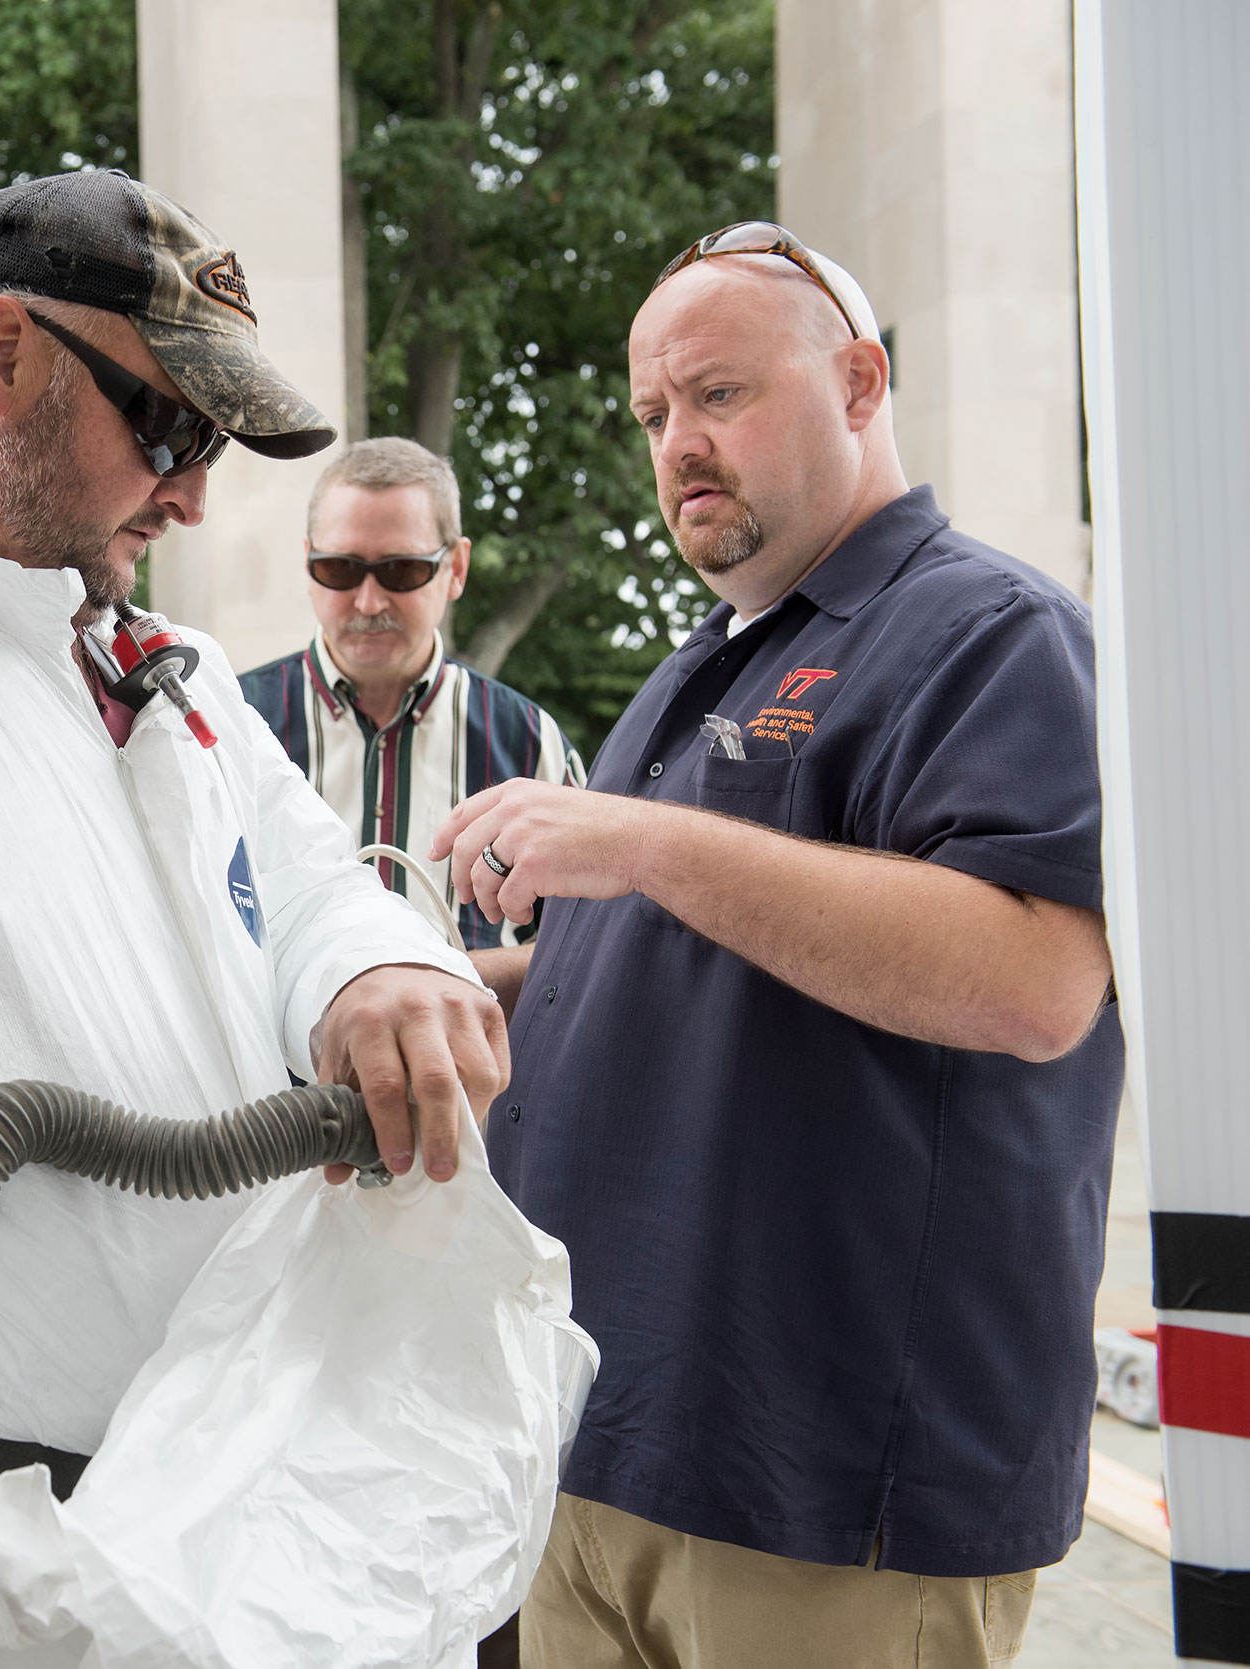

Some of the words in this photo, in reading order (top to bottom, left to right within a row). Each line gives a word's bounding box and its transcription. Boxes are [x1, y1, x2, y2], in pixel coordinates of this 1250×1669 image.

[776, 668, 838, 700] VT
[767, 718, 787, 728] and
[788, 719, 815, 736] Safety
[232, 890, 255, 909] Tyvek
